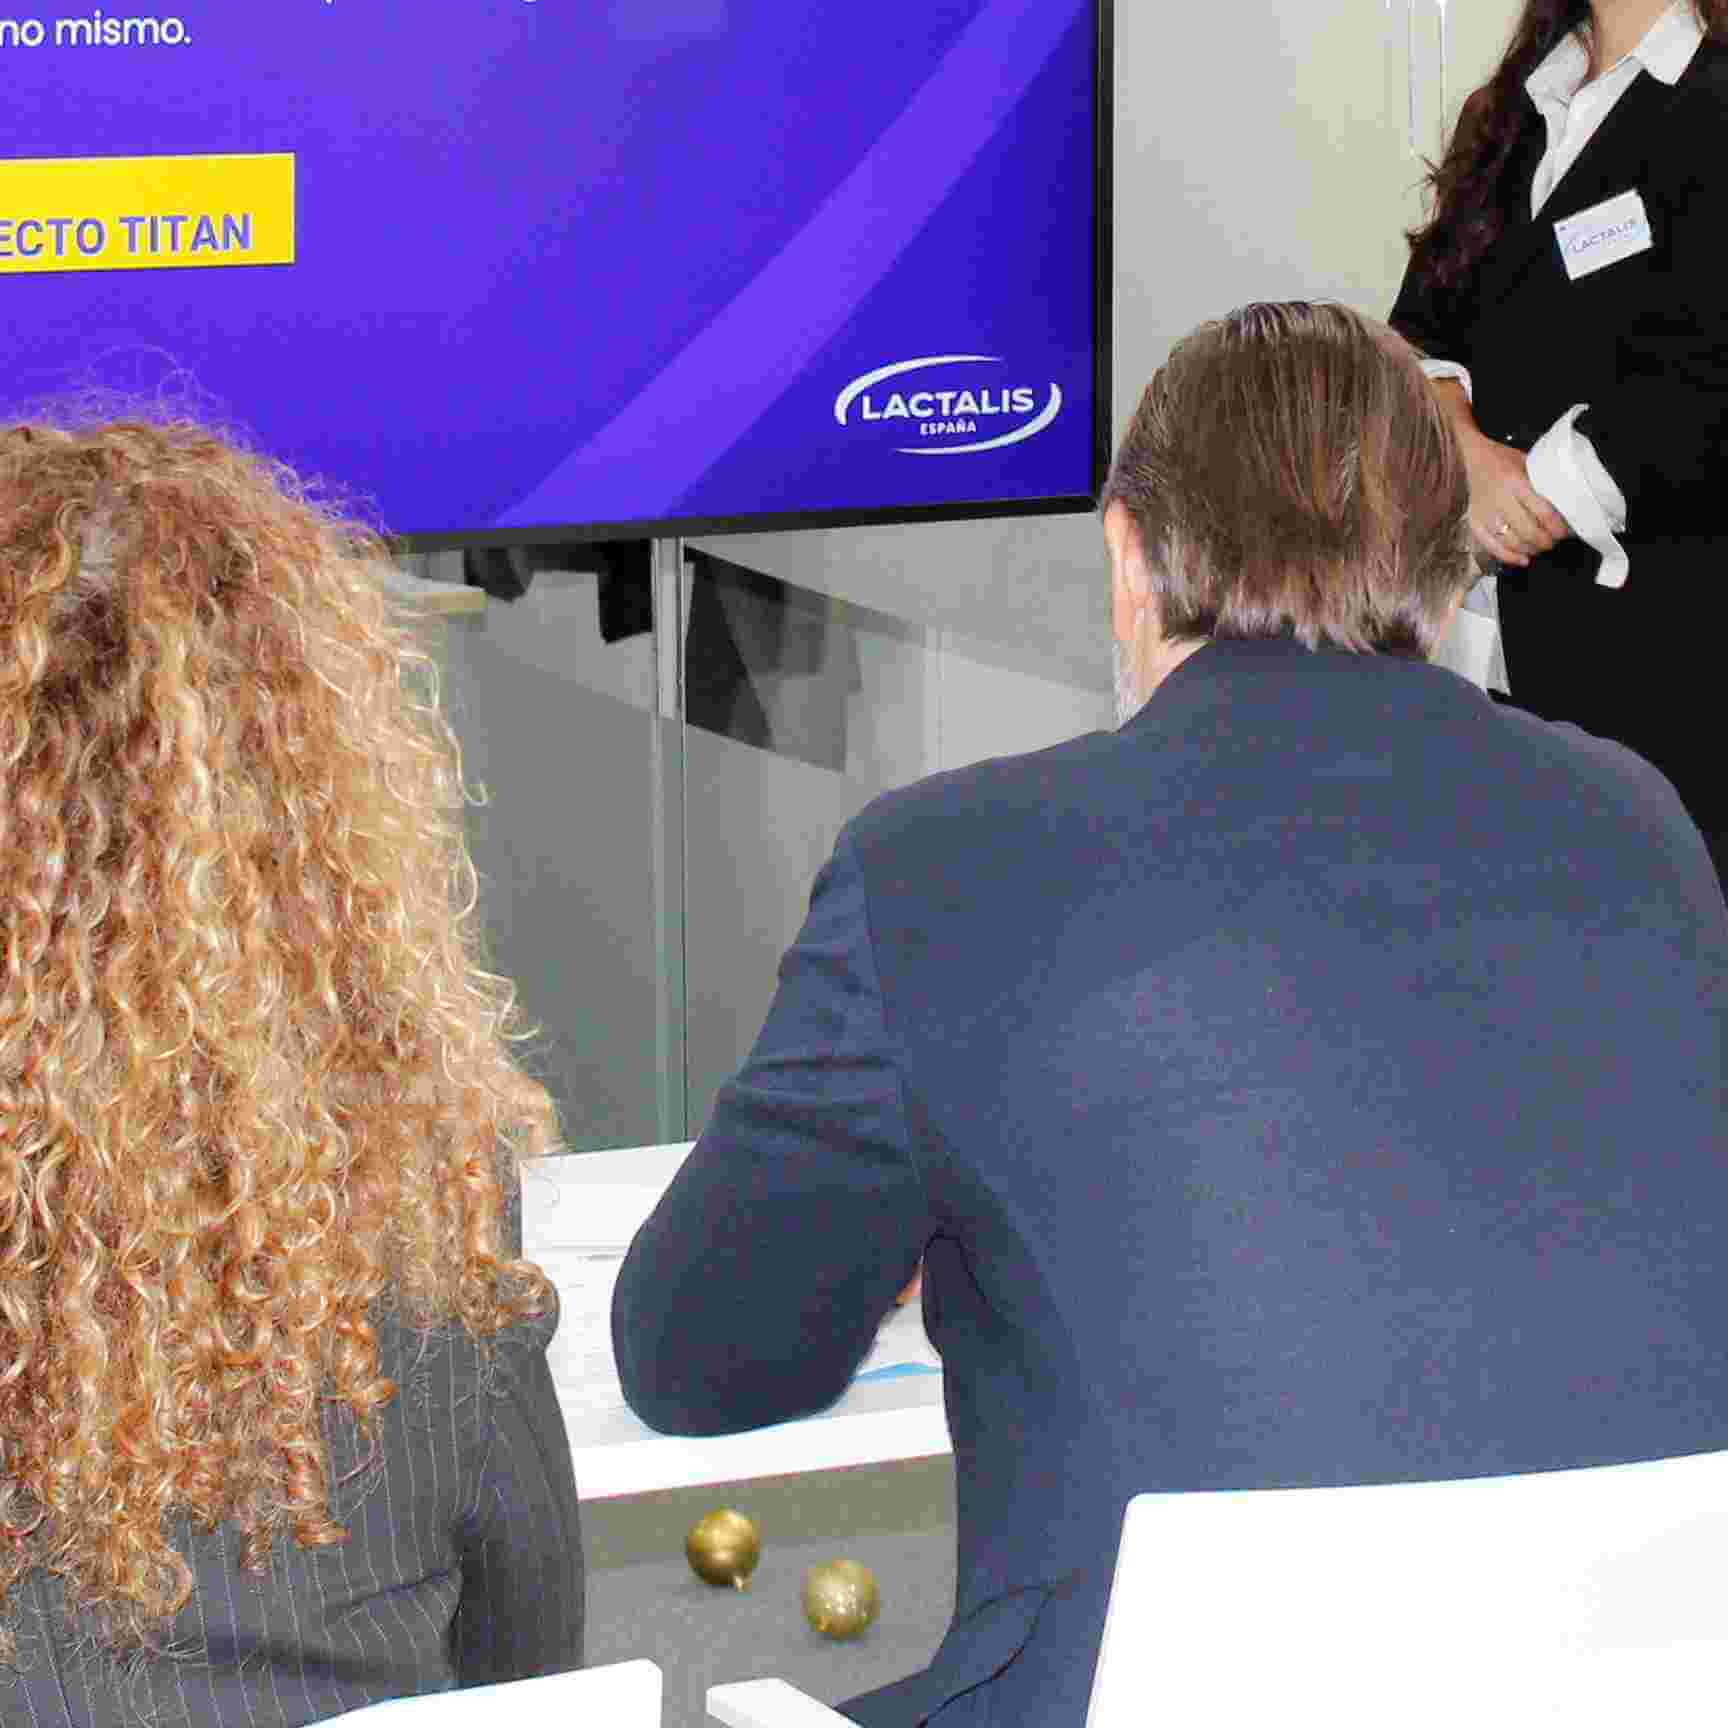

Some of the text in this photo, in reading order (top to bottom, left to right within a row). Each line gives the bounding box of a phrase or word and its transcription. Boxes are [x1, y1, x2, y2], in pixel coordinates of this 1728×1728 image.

[55, 11, 192, 48] mismo.
[122, 212, 253, 254] TITAN
[861, 387, 1035, 420] LACTALIS
[919, 418, 977, 436] ESPAÑA
